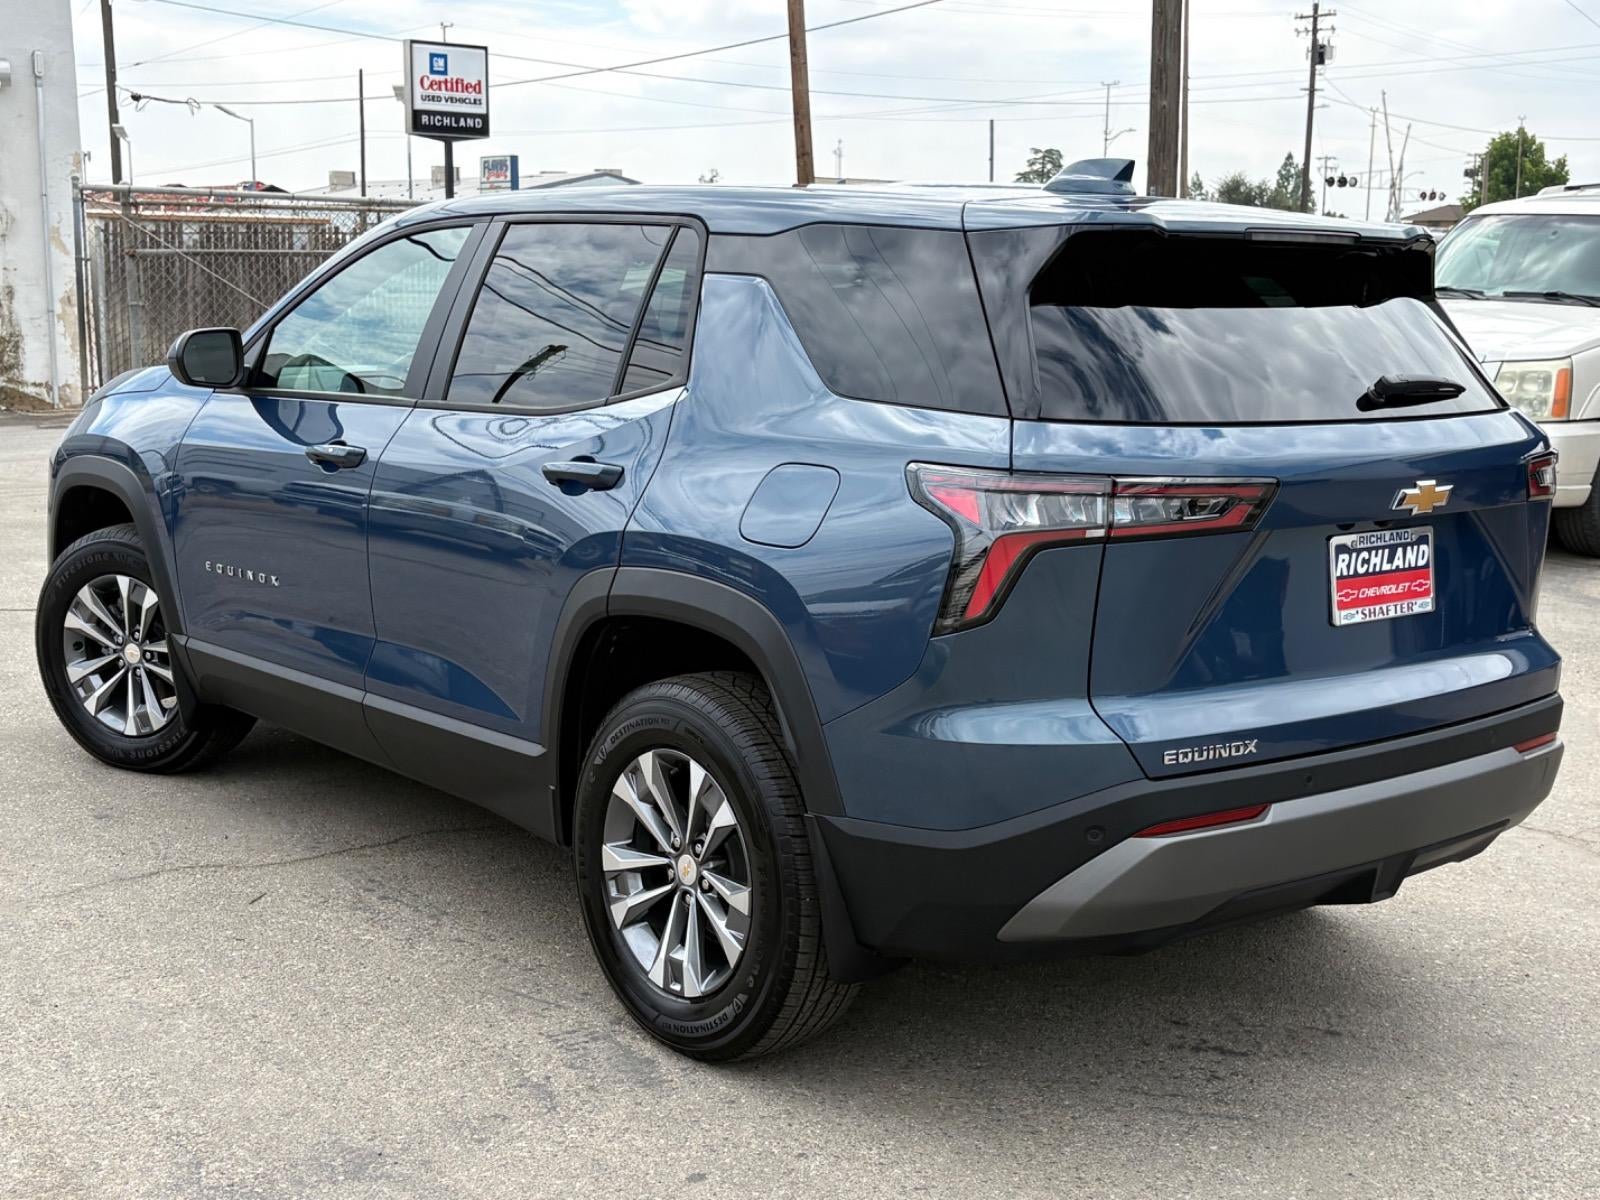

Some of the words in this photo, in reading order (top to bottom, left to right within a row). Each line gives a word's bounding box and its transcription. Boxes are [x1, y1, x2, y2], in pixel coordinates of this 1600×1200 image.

[433, 57, 445, 69] GM
[420, 75, 482, 95] Certified
[420, 94, 442, 103] USED
[444, 95, 482, 105] VEHICLES
[422, 115, 483, 129] RICHLAND
[1358, 531, 1410, 547] RICHLAND
[1336, 544, 1429, 577] RICHLAND
[205, 561, 279, 586] EQUINOX
[1359, 582, 1410, 598] CHEVROLET
[609, 717, 659, 745] DESTINATION
[1163, 739, 1258, 765] EQUINOX
[672, 1012, 728, 1033] DESTINATION
